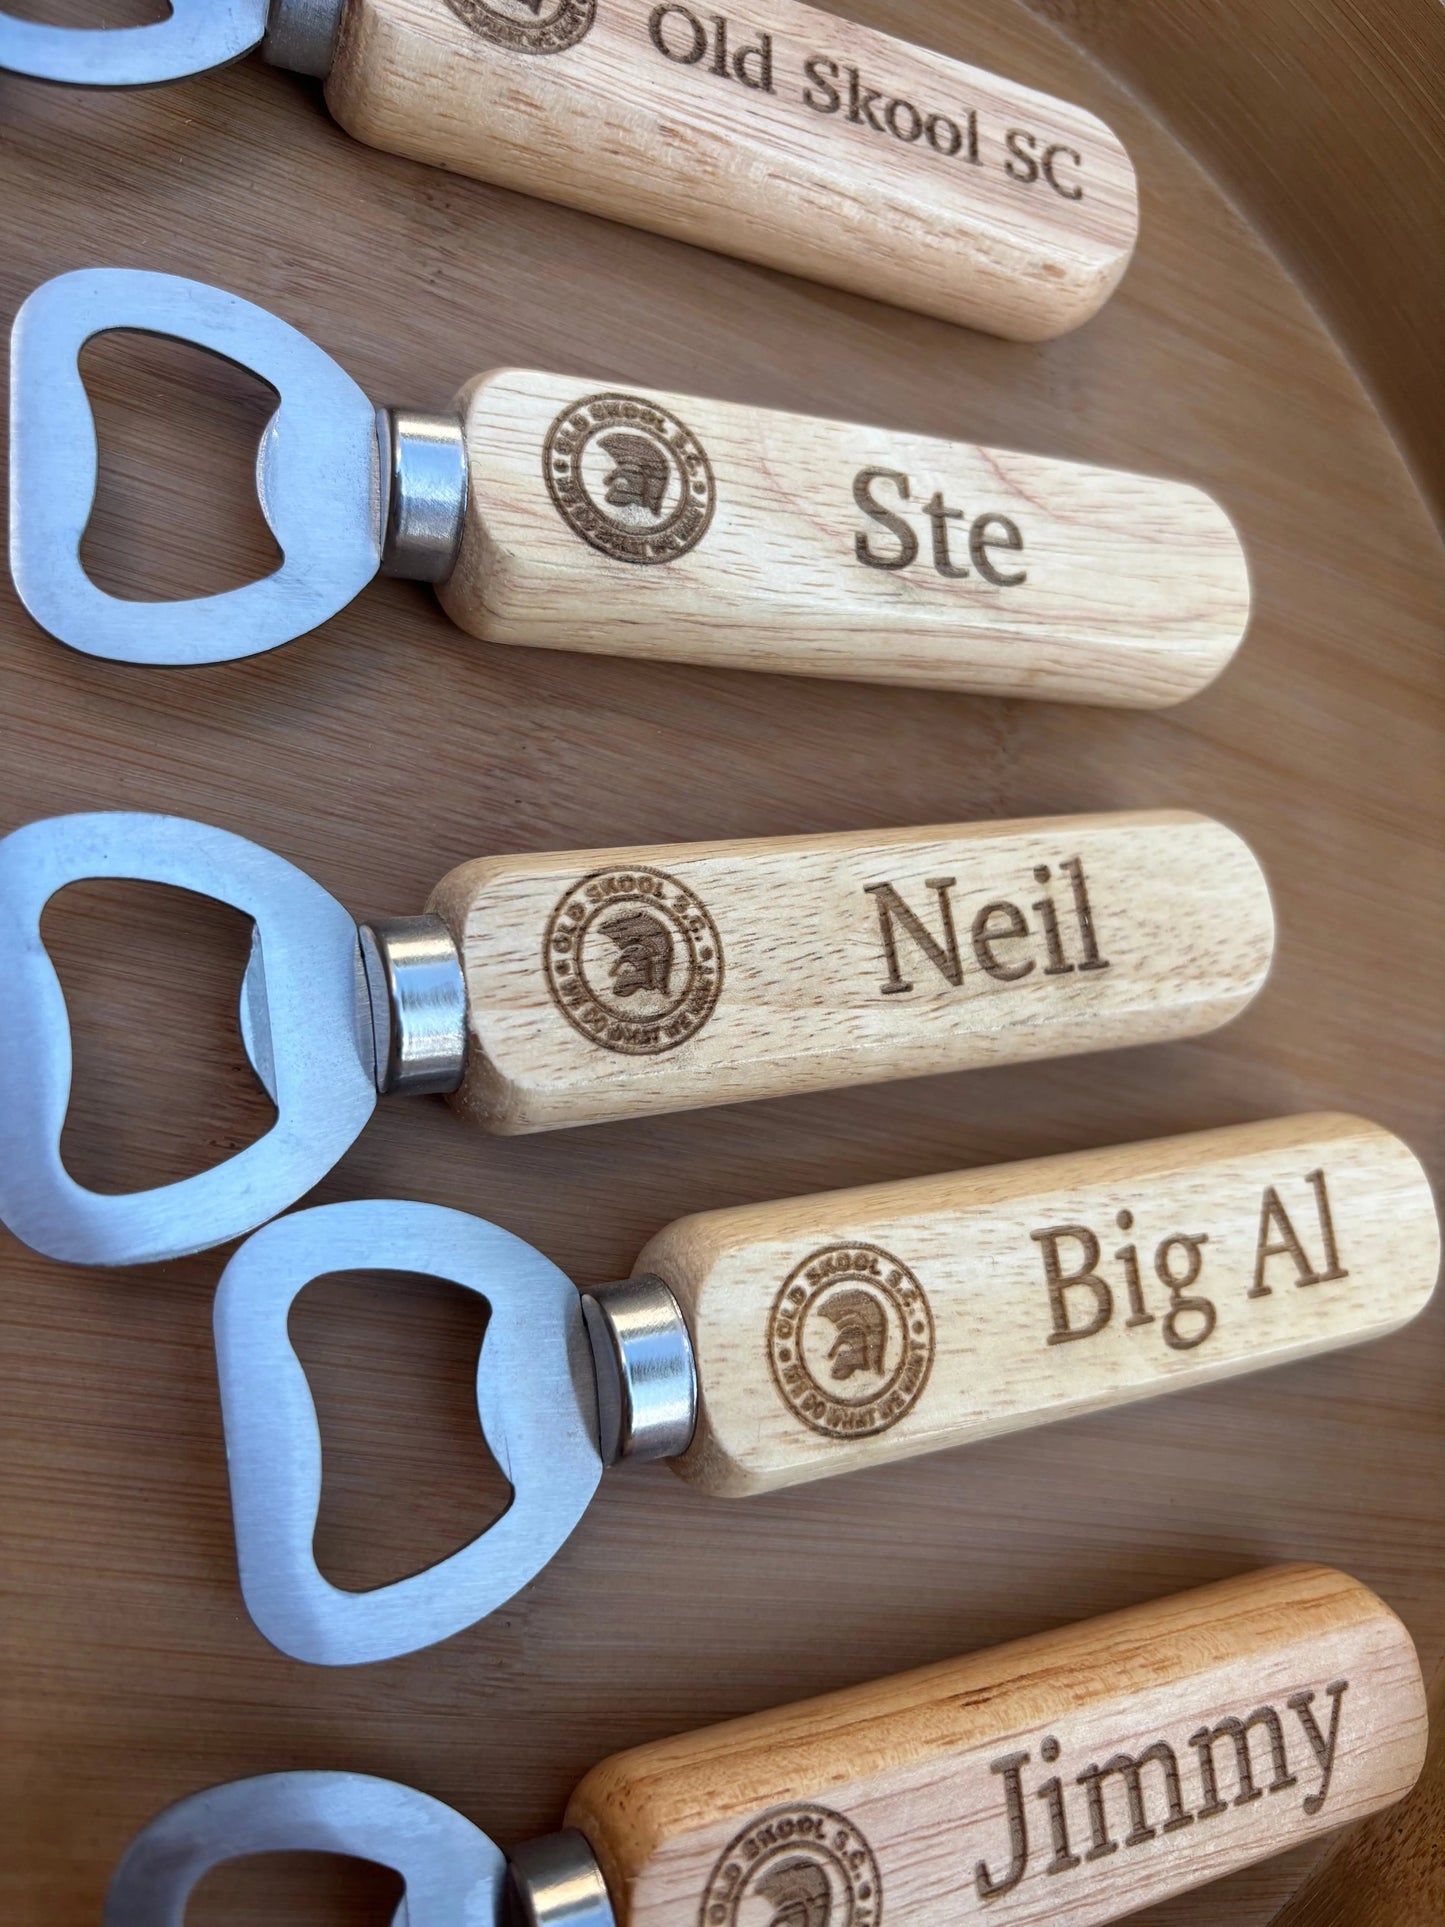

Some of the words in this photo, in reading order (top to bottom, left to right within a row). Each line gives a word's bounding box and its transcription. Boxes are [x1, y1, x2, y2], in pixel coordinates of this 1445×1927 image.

[648, 3, 776, 95] Old
[803, 54, 984, 167] Skool
[1004, 127, 1083, 201] SC
[852, 466, 1027, 587] Ste
[863, 856, 1110, 994] Neil
[1030, 1208, 1217, 1350] Big
[1247, 1167, 1349, 1299] Al
[974, 1679, 1349, 1899] Jimmy
